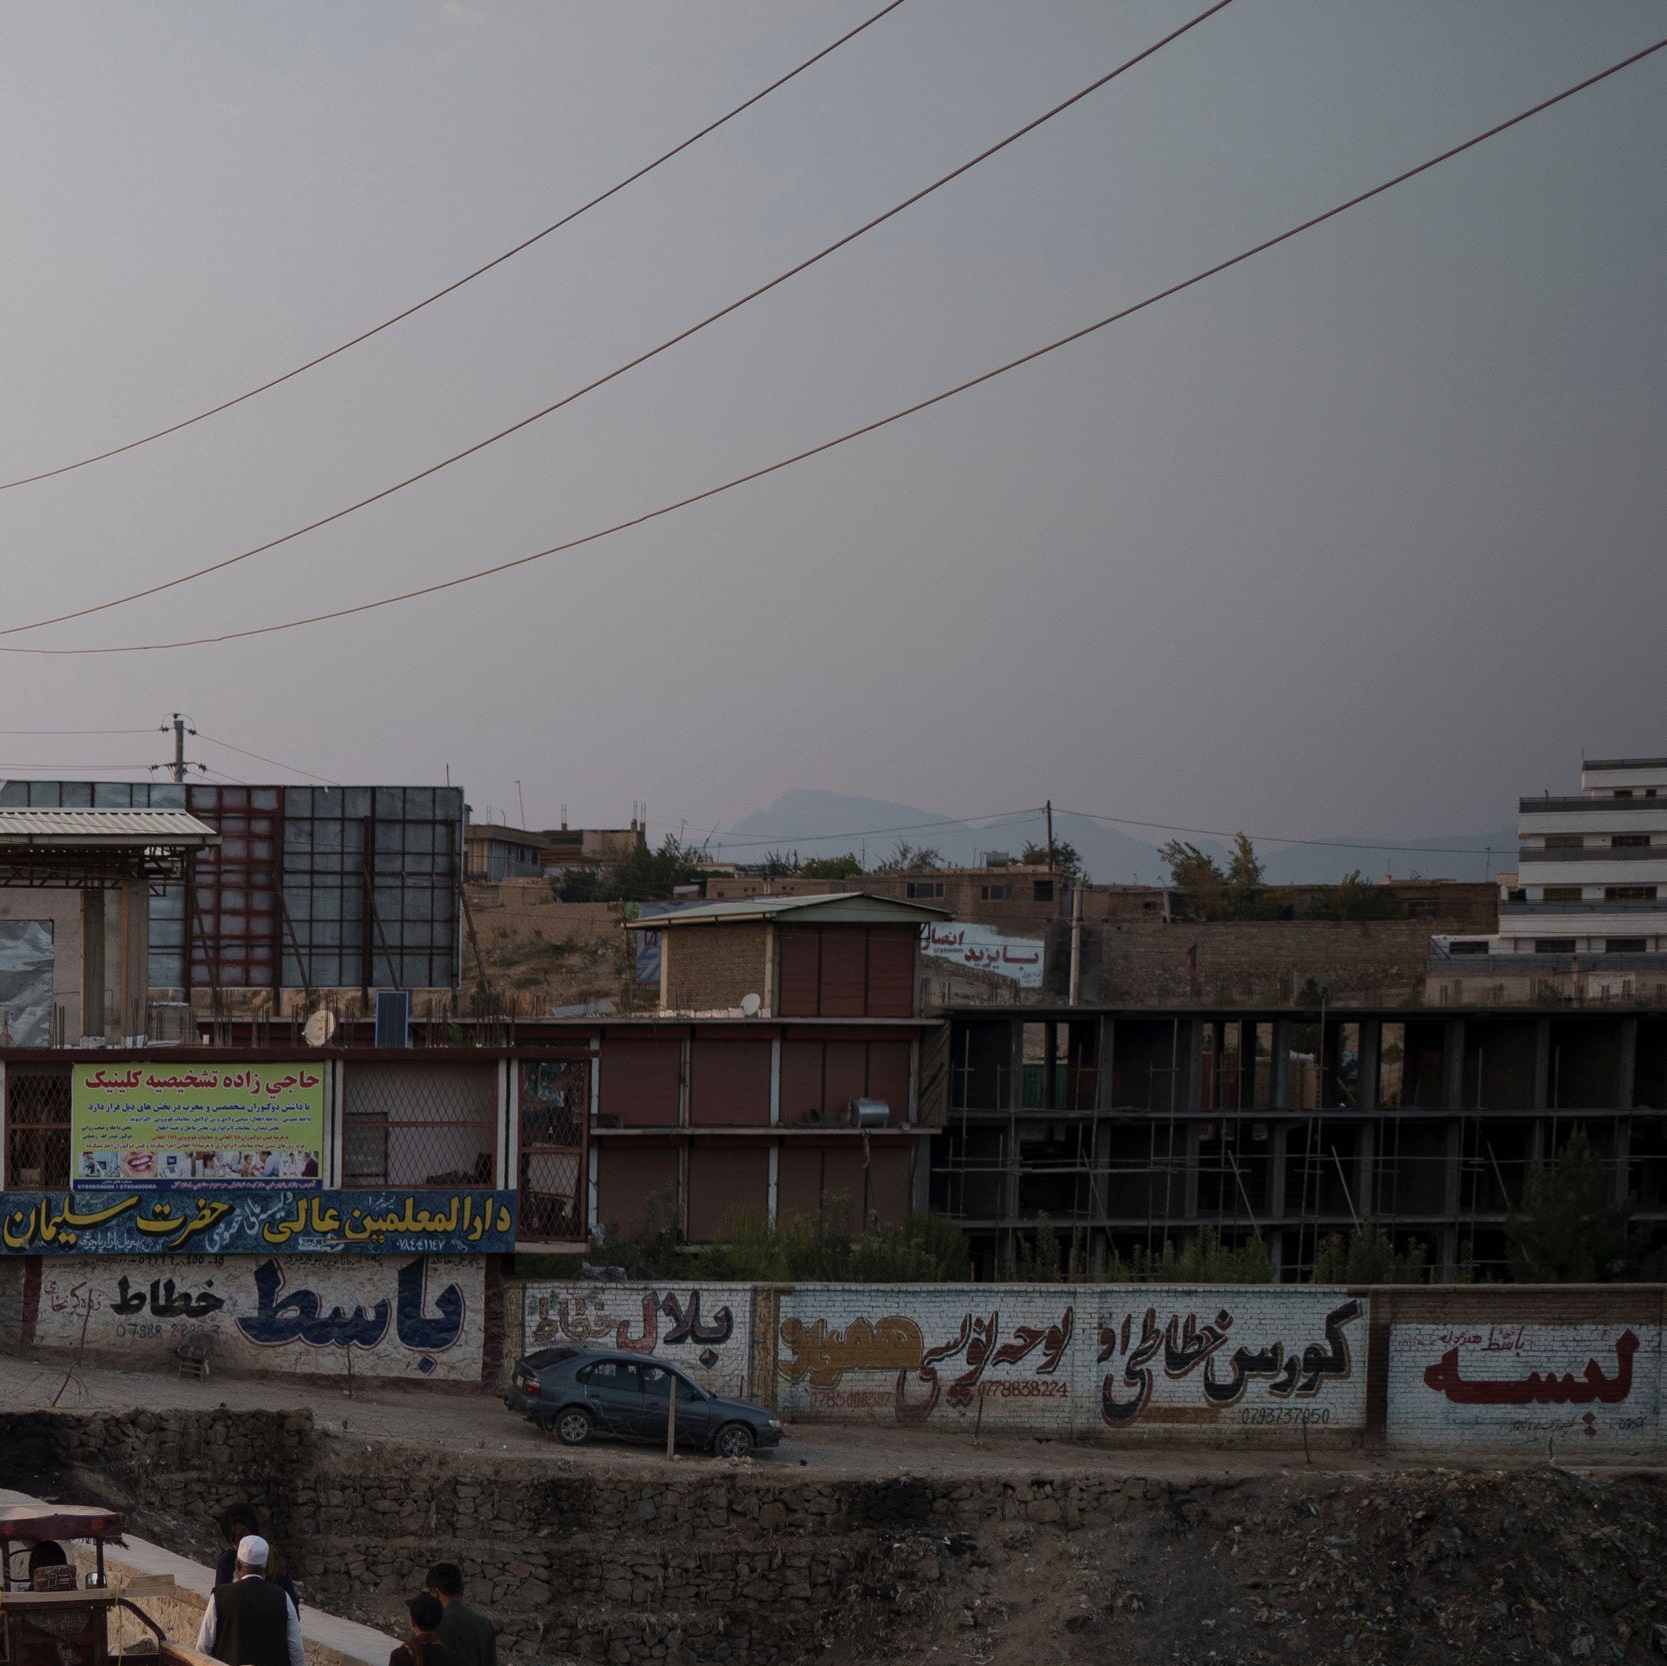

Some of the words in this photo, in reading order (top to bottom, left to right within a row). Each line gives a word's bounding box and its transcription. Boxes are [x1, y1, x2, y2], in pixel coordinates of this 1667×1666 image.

[85, 1070, 143, 1094] کلینیک
[145, 1068, 218, 1094] تشخیصیه
[223, 1070, 261, 1094] زاده
[3, 1194, 140, 1249] سلیمان
[136, 1197, 234, 1250] حضرت
[262, 1195, 341, 1244] عالی
[110, 1275, 226, 1318] خطاط
[235, 1255, 467, 1374] باسط
[616, 1289, 733, 1369] بلال
[992, 1306, 1074, 1375] لوحه
[1097, 1314, 1131, 1363] او
[1204, 1299, 1363, 1407] کورس
[895, 1311, 999, 1423] نویسی
[978, 1381, 1068, 1397] 0778838224
[1101, 1307, 1233, 1427] خطاطی
[1424, 1327, 1640, 1437] لیسه
